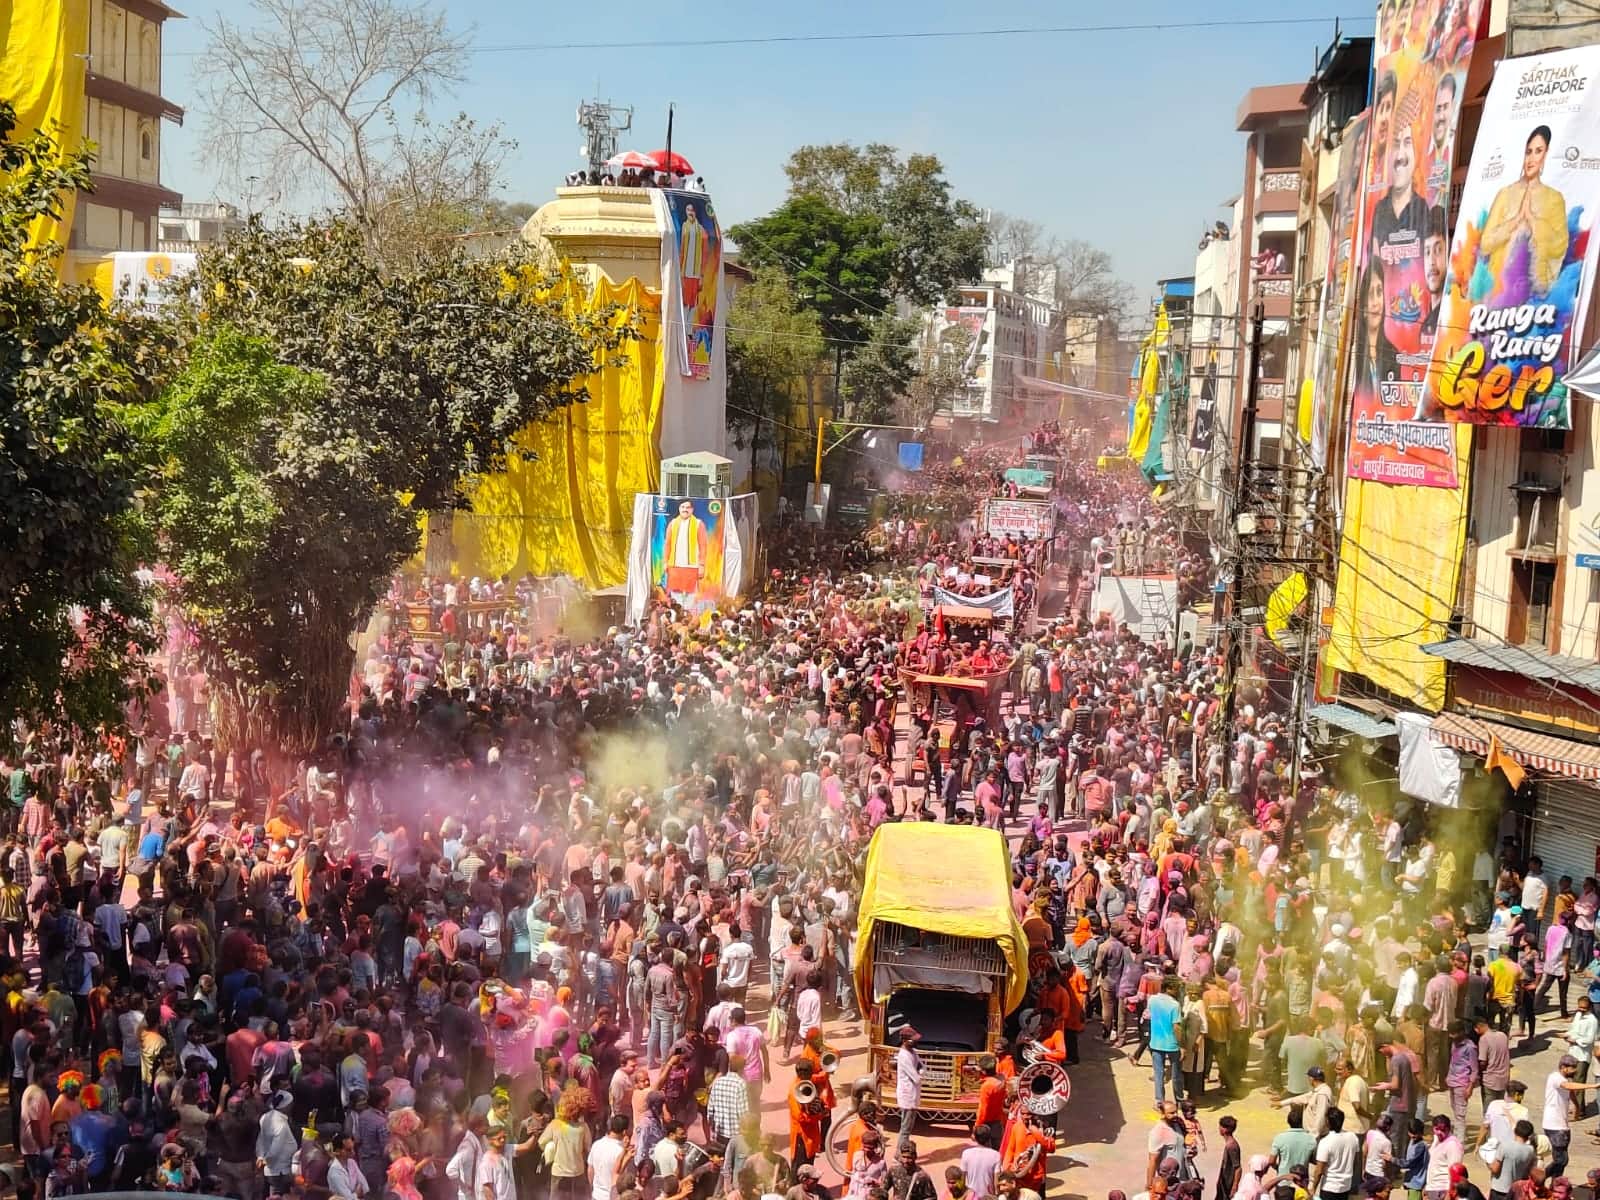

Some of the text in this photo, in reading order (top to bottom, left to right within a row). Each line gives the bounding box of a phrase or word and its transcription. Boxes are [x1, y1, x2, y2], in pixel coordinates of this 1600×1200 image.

[1515, 77, 1588, 100] SINGAPORE
[1520, 64, 1579, 85] SARTHAK
[1469, 304, 1556, 333] Ranga
[1490, 330, 1563, 362] Rang
[1439, 341, 1554, 411] Ger
[1475, 689, 1504, 709] THE
[1506, 695, 1551, 716] TIMES
